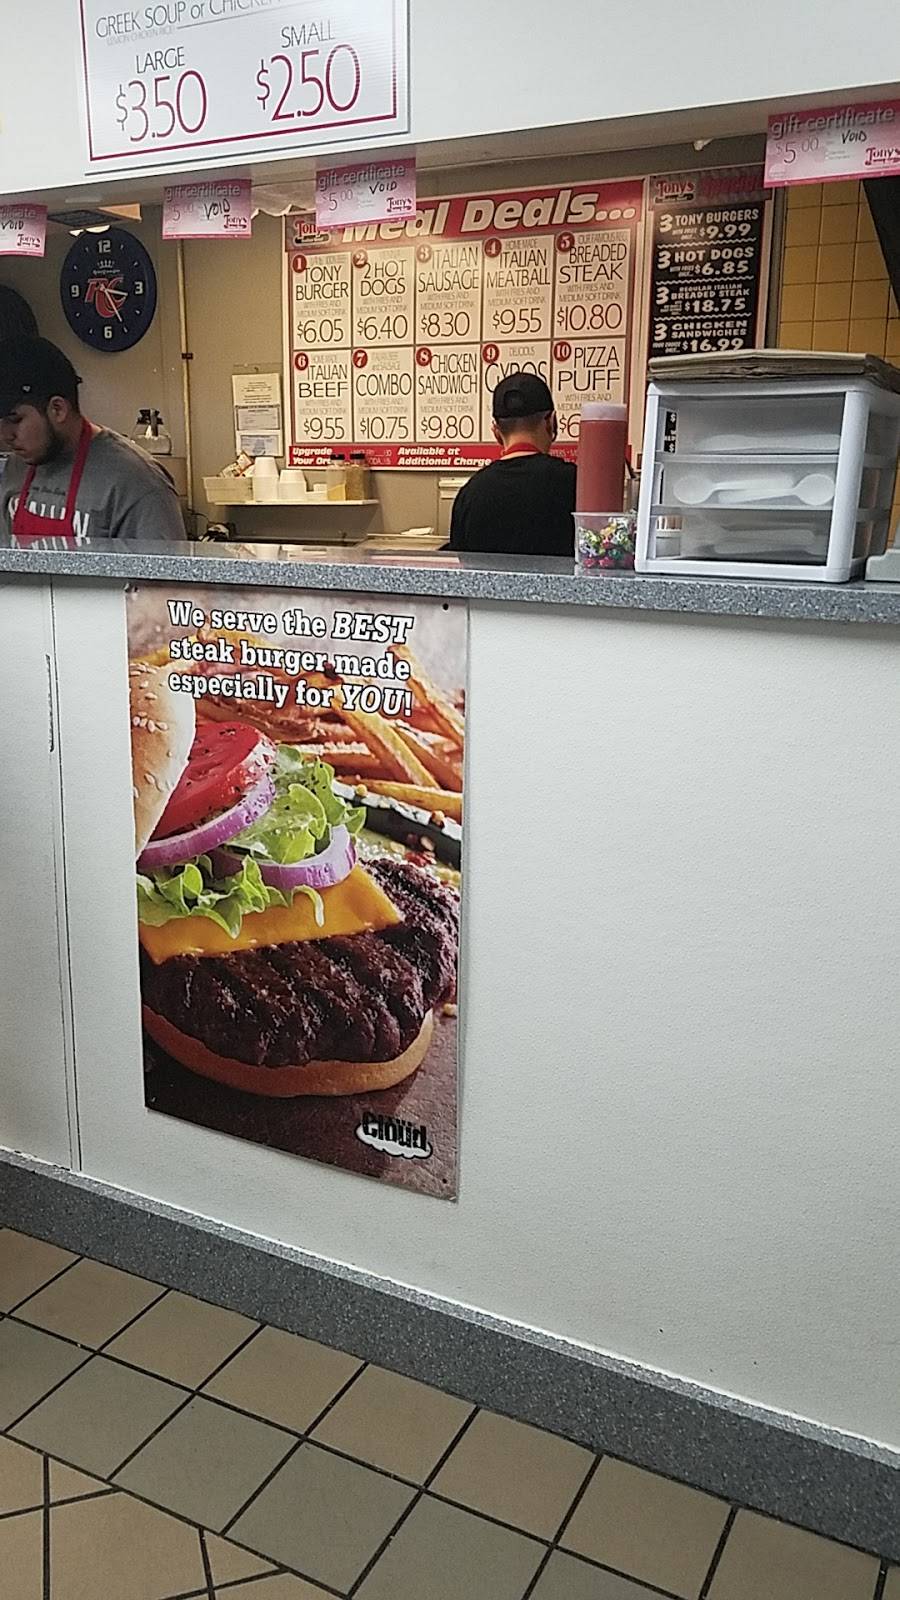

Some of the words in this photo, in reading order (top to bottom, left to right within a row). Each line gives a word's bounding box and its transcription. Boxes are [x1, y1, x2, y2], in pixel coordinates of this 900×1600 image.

[95, 12, 142, 38] GREEK
[144, 1, 187, 29] SOUP
[190, 3, 205, 19] or
[281, 19, 336, 49] SMALL
[135, 47, 185, 74] LARGE
[256, 44, 361, 121] $2.50
[116, 70, 207, 142] $3.50
[770, 113, 802, 140] gift
[805, 107, 896, 131] certificate
[842, 130, 867, 144] VOID
[319, 172, 340, 192] gift
[343, 164, 407, 186] certificate
[369, 181, 397, 195] VOID
[185, 183, 241, 198] certificate
[204, 198, 231, 220] VOID
[460, 190, 636, 233] Deals...
[2, 219, 24, 230] VOID
[660, 214, 673, 233] 3
[675, 212, 704, 227] TONY
[706, 208, 759, 224] BURGERS
[699, 223, 752, 239] $9.99
[98, 240, 111, 253] 12
[569, 243, 627, 264] BREADED
[432, 247, 478, 269] ITALIAN
[500, 249, 547, 268] ITALIAN
[657, 250, 671, 269] 3
[674, 250, 706, 263] HOT
[710, 247, 755, 261] DOGS
[694, 260, 749, 276] $6.85
[304, 265, 342, 283] TONY
[364, 263, 371, 279] 2
[374, 260, 407, 278] HOT
[486, 267, 550, 288] MEATBALL
[559, 262, 623, 283] STEAK
[71, 285, 79, 298] 9
[134, 281, 143, 295] 3
[296, 282, 349, 301] BURGER
[360, 277, 406, 296] DOGS
[418, 269, 479, 293] SAUSAGE
[656, 286, 669, 305] 3
[714, 283, 743, 291] ITALIAN
[671, 291, 716, 300] BREADED
[719, 288, 750, 298] STEAK
[685, 297, 746, 313] $18.75
[421, 311, 470, 337] $8.30
[492, 308, 541, 334] $9.55
[557, 303, 622, 331] $10.80
[104, 326, 112, 339] 6
[297, 318, 344, 343] $6.05
[357, 315, 408, 341] $6.40
[654, 323, 667, 341] 3
[671, 320, 748, 331] CHICKEN
[671, 328, 748, 339] SANDWICHES
[682, 337, 744, 352] $16.99
[430, 353, 477, 374] CHICKEN
[574, 346, 620, 368] PIZZA
[307, 364, 348, 380] ITALIAN
[558, 369, 620, 392] PUFF
[298, 381, 348, 398] BEEF
[356, 373, 412, 396] COMBO
[418, 374, 477, 395] SANDWICH
[303, 417, 345, 440] $9.55
[360, 416, 408, 439] $10.75
[421, 415, 474, 439] $9.80
[292, 447, 333, 457] Upgrade
[293, 456, 314, 466] Your
[398, 446, 445, 457] Available
[447, 447, 460, 456] at
[398, 457, 452, 467] Additional
[453, 457, 492, 467] Charge
[167, 600, 205, 628] We
[210, 609, 277, 633] serve
[282, 608, 326, 638] the
[331, 611, 415, 644] BEST
[169, 637, 235, 663] steak
[240, 639, 329, 676] burger
[334, 651, 411, 681] made
[168, 672, 289, 709] especially
[295, 679, 334, 708] for
[341, 682, 412, 717] YOU!
